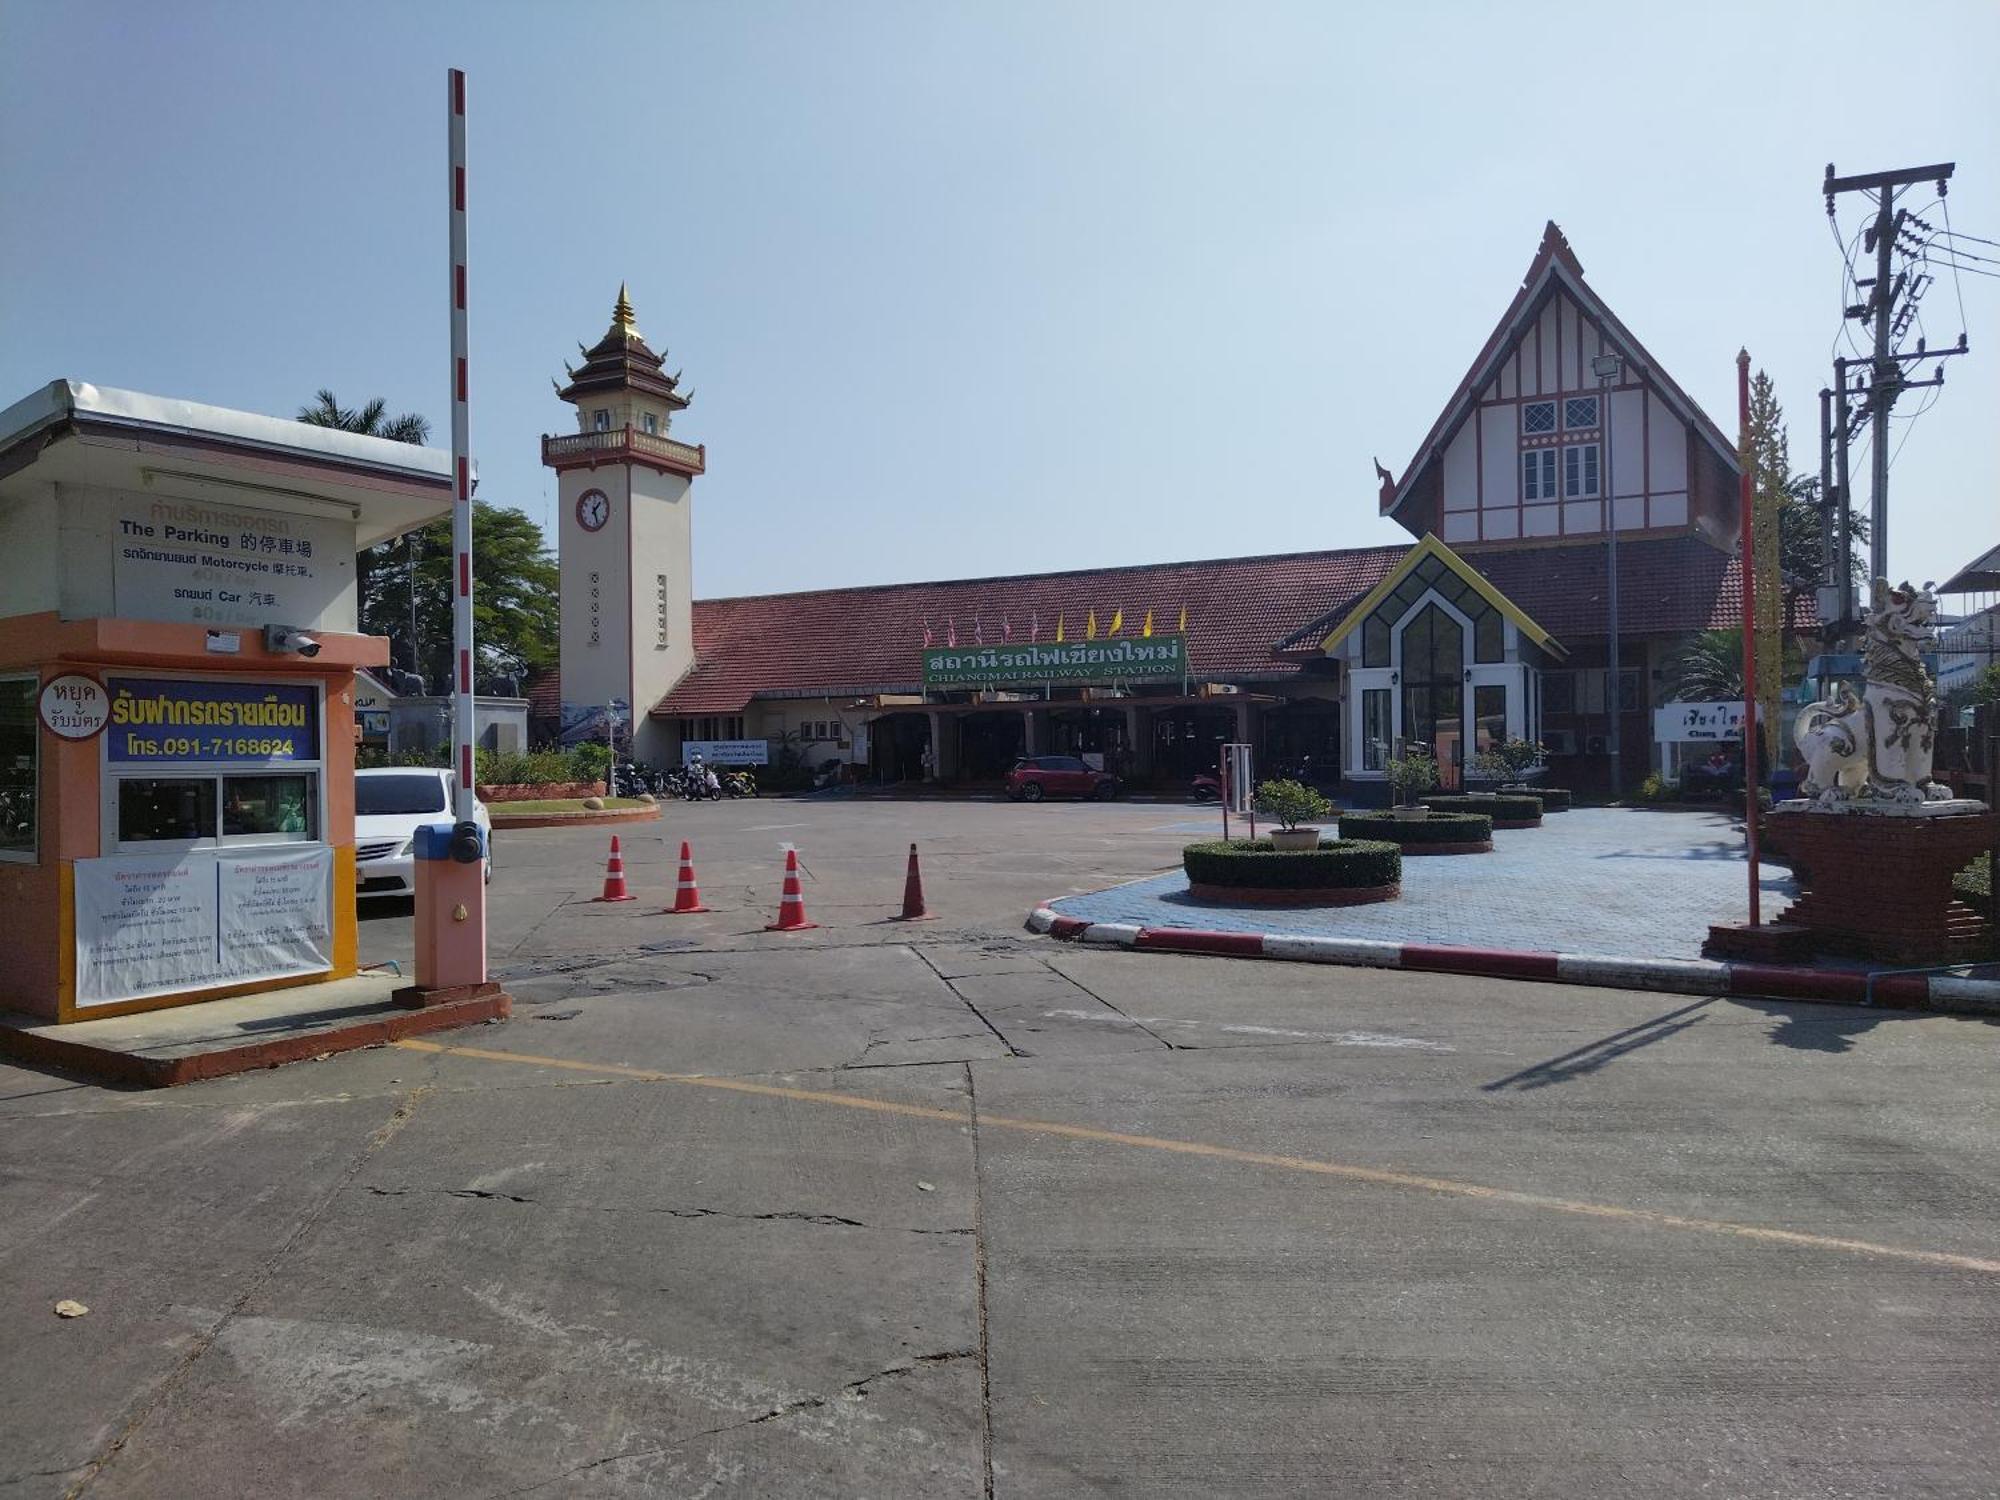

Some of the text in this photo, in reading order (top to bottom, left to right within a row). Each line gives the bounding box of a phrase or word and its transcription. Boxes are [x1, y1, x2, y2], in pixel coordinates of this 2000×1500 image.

[120, 520, 155, 538] The
[164, 525, 230, 548] Parking
[202, 555, 269, 574] Motorcycle
[218, 591, 242, 604] Car
[928, 640, 1179, 671] สถานีรถไฟเชียงใหม่
[1022, 667, 1094, 680] RAILWAY
[1104, 664, 1177, 677] STATION
[53, 685, 96, 709] หยุด
[51, 709, 101, 728] รับบัตร
[112, 689, 305, 727] รับฝากรถรายเดือน
